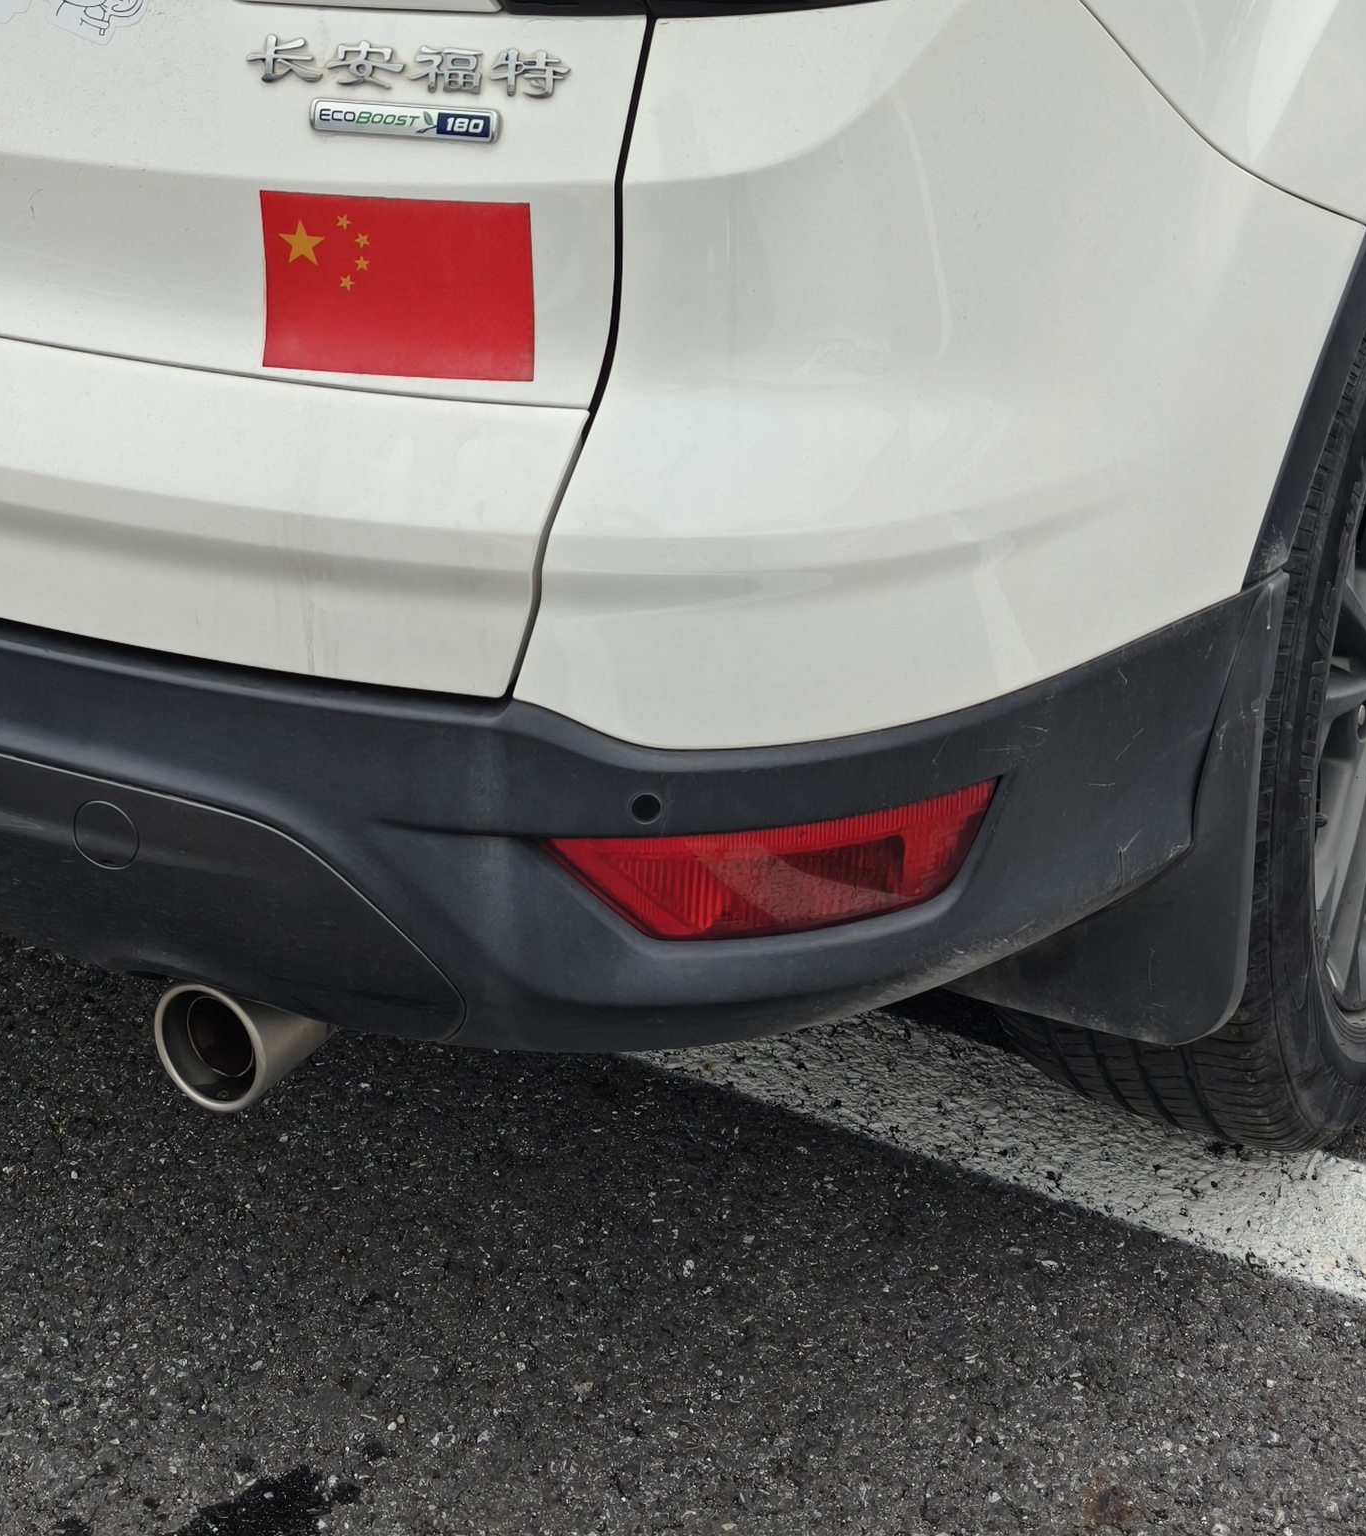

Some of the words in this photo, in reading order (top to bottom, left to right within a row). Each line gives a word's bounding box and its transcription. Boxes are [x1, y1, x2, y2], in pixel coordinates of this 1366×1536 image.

[246, 34, 572, 99] 长安福特
[445, 116, 485, 134] 180
